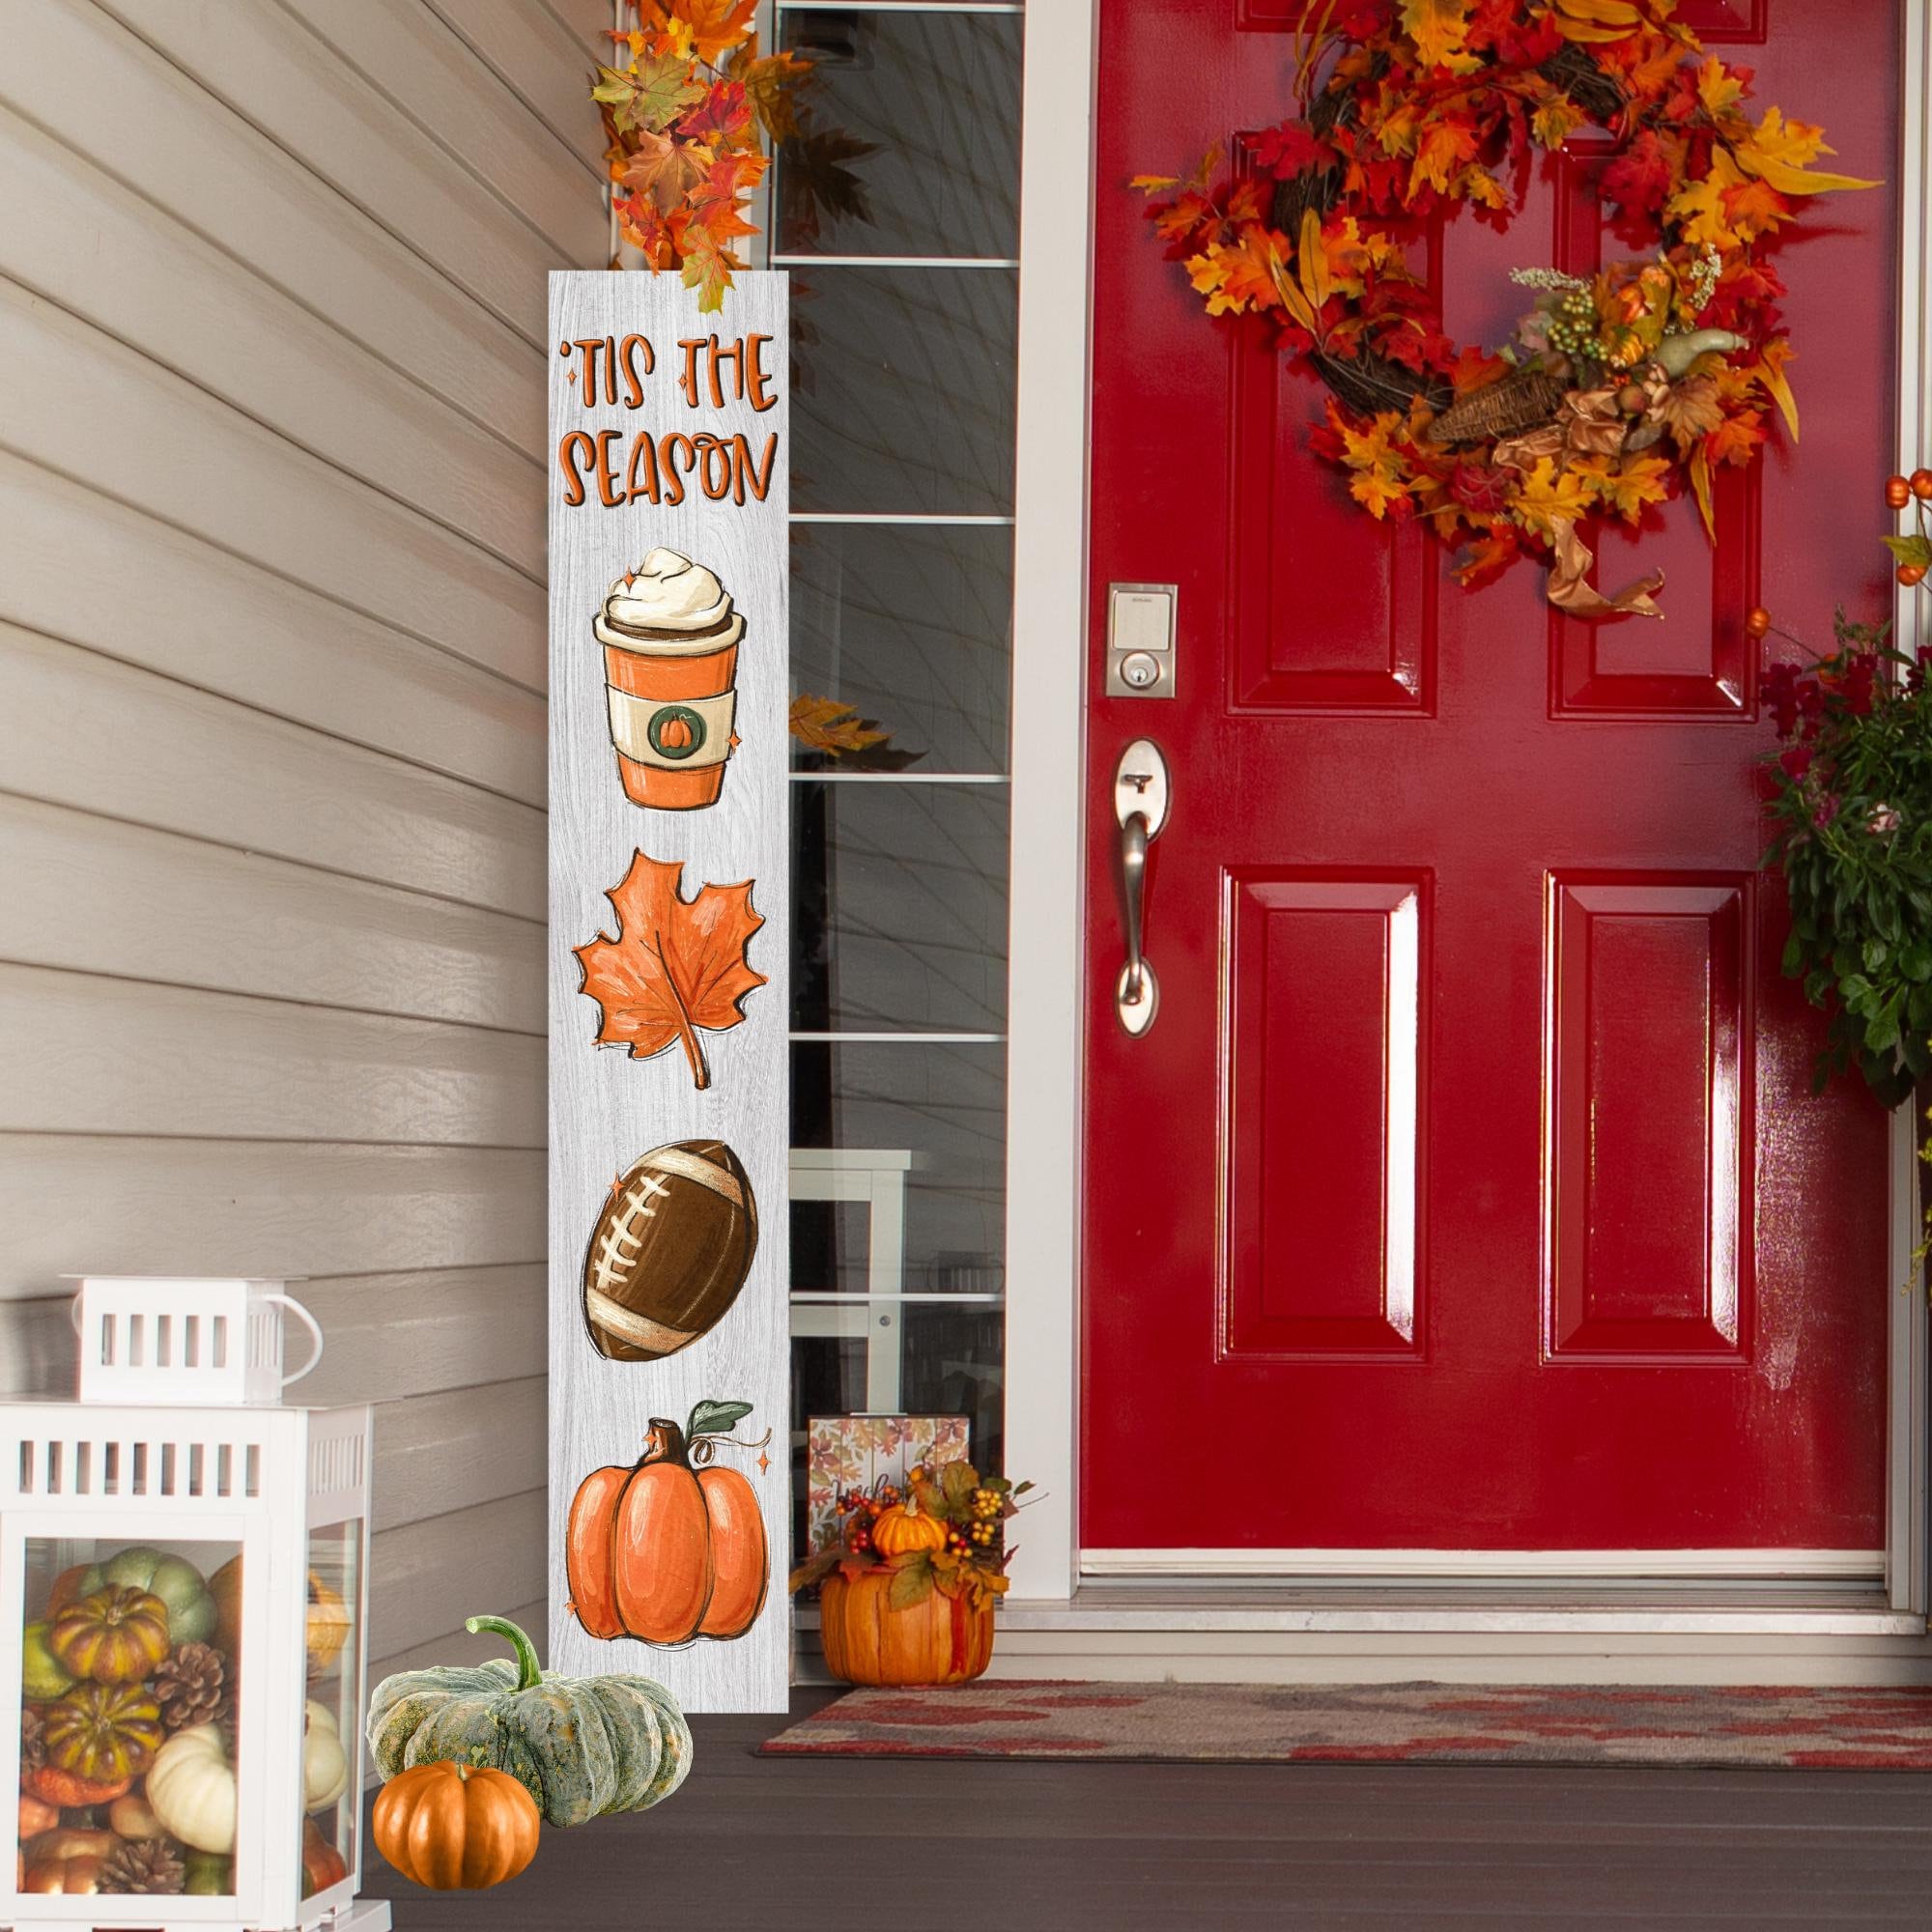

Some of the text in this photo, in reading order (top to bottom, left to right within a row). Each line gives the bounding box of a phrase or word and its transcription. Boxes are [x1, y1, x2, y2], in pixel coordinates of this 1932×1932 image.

[560, 333, 778, 412] 'TIS THE
[559, 430, 778, 507] SEASON
